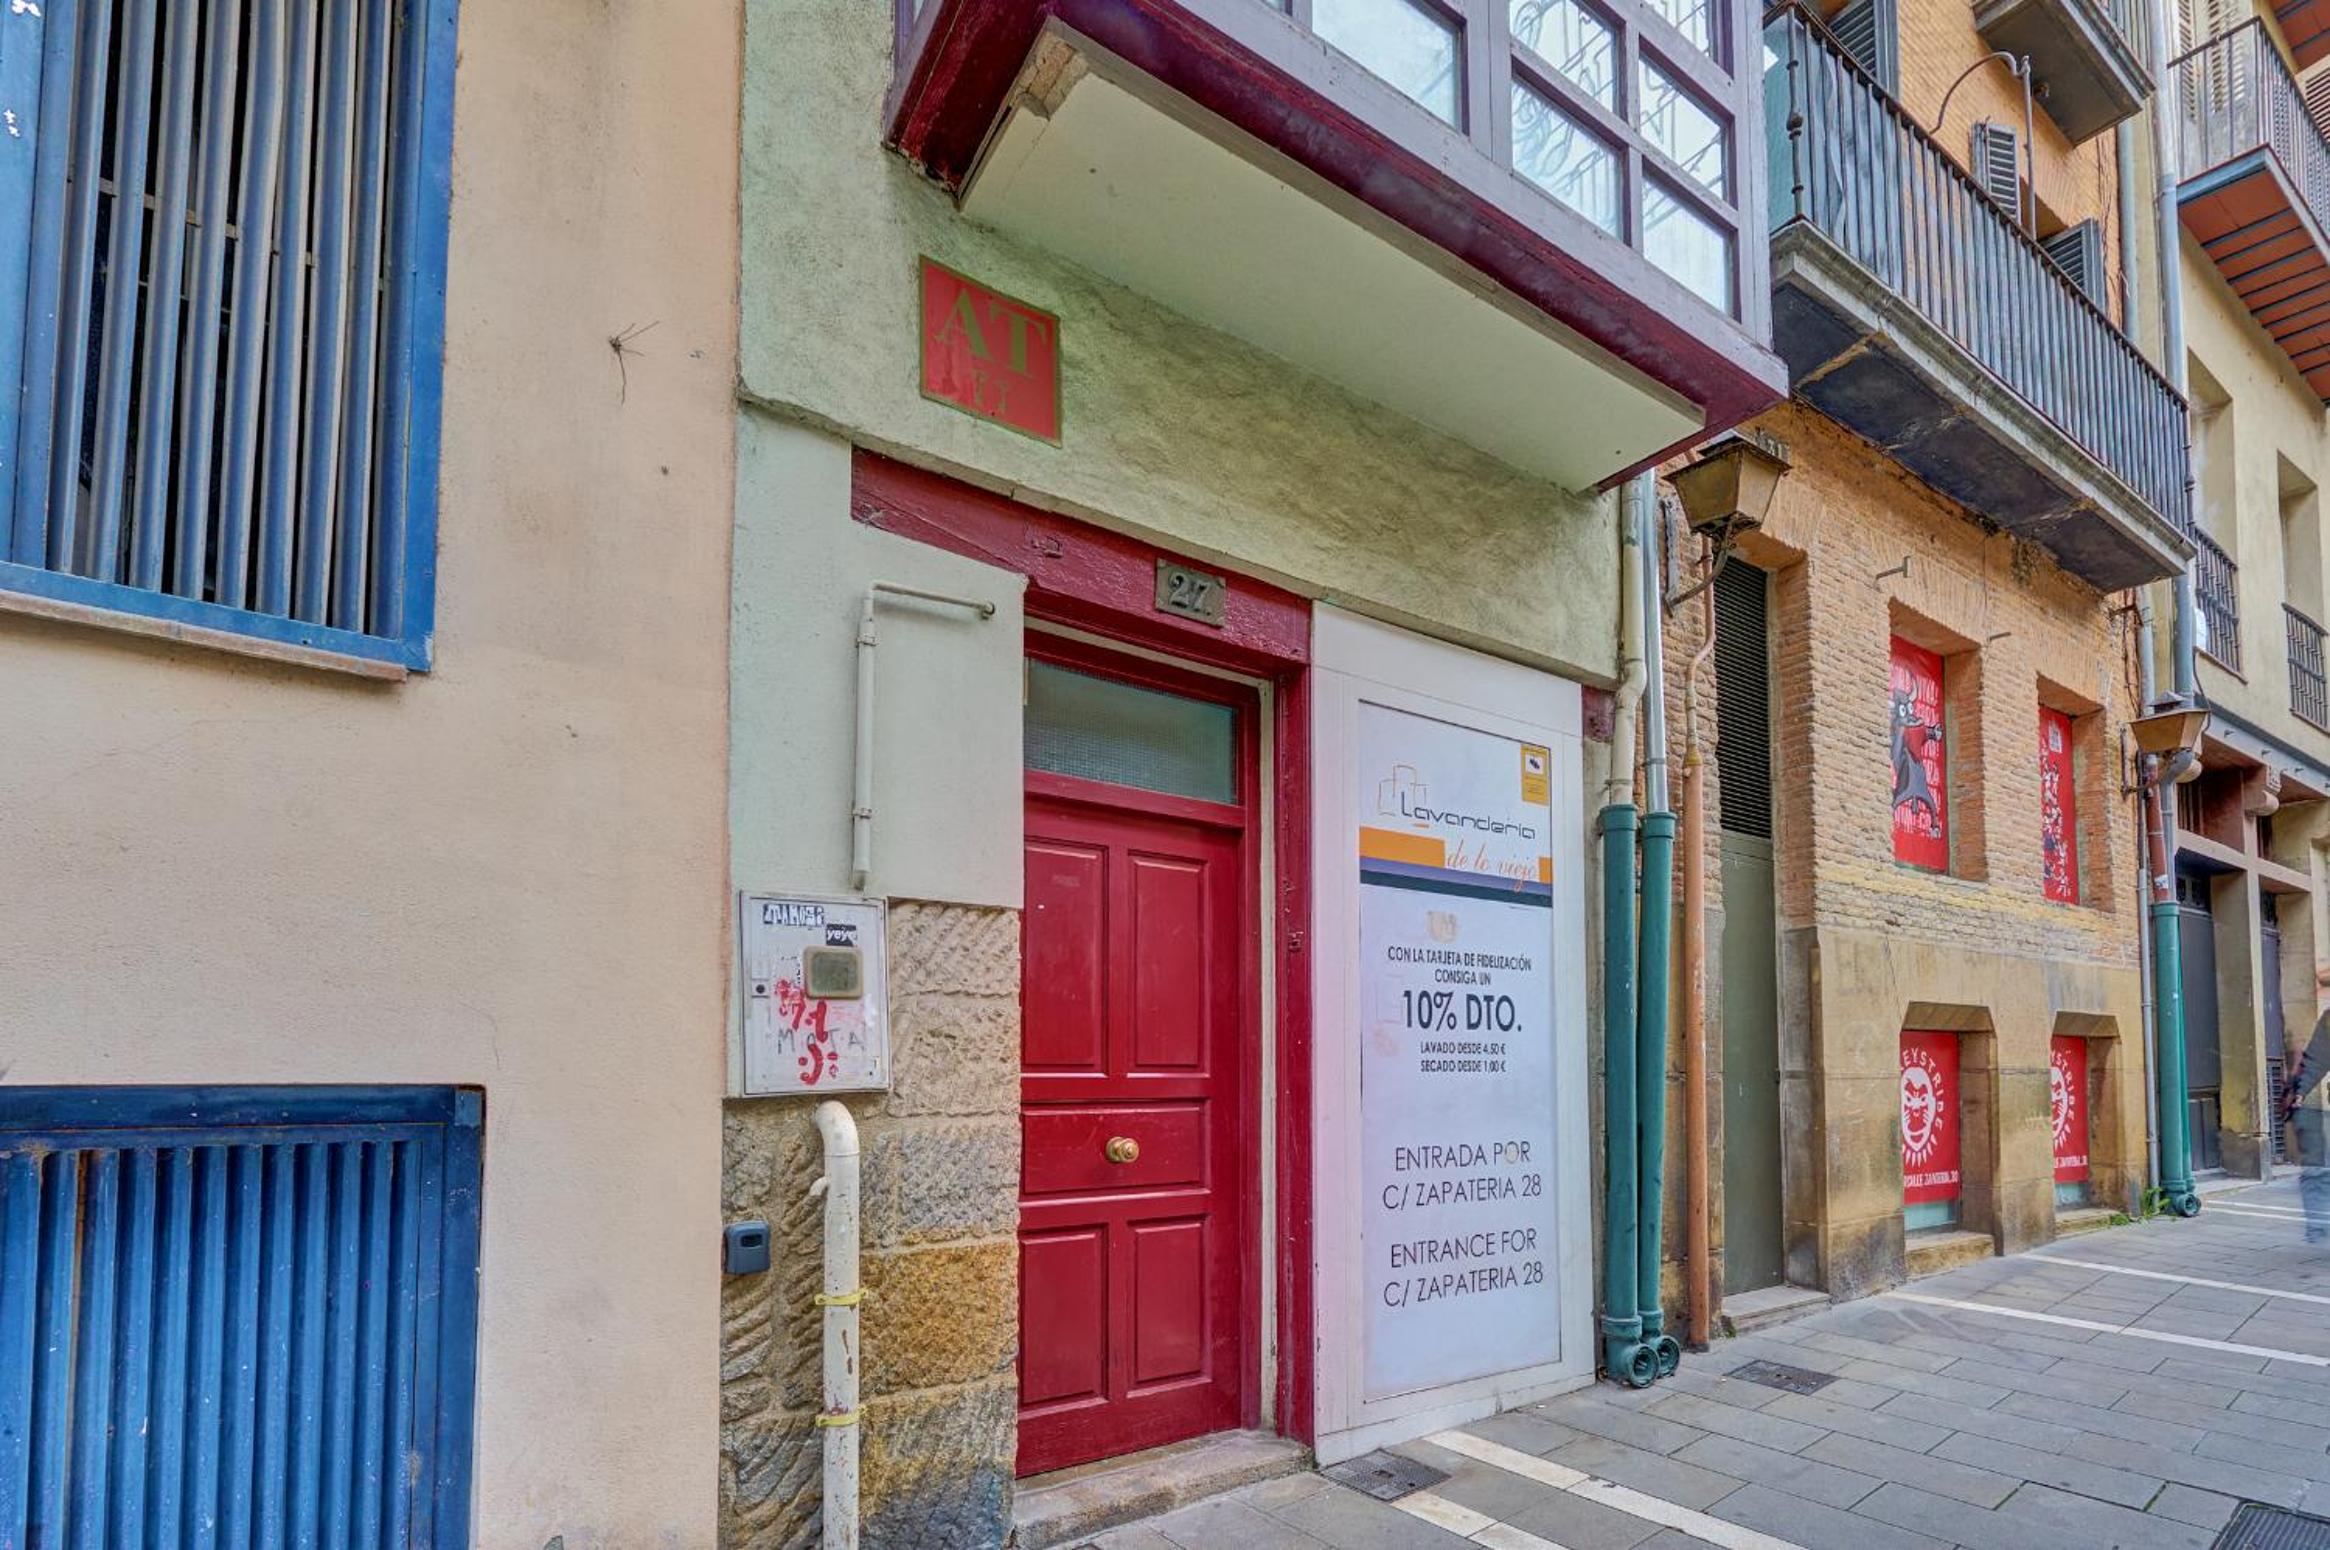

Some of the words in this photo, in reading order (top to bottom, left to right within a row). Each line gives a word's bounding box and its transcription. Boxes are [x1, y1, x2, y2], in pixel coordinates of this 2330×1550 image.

[935, 288, 1048, 378] AT
[1388, 946, 1411, 961] CON
[1413, 948, 1425, 963] LA
[1426, 949, 1462, 966] TARJETA
[1464, 952, 1476, 967] DE
[1435, 968, 1477, 985] CONSIGA
[1403, 989, 1457, 1031] 10%
[1466, 994, 1522, 1032] DTO.
[1420, 1041, 1456, 1054] LAVADO
[1457, 1042, 1481, 1054] DESDE
[1420, 1060, 1456, 1073] SECADO
[1457, 1060, 1481, 1073] DESDE
[1395, 1144, 1487, 1171] ENTRADA
[1493, 1141, 1531, 1165] POR
[1382, 1184, 1409, 1210] C/
[1416, 1177, 1516, 1207] ZAPATERIA
[1522, 1173, 1542, 1197] 28
[1391, 1232, 1495, 1268] ENTRANCE
[1501, 1228, 1536, 1254] FOR
[1383, 1279, 1410, 1307] C/
[1417, 1267, 1518, 1303] ZAPATERIA
[1523, 1261, 1543, 1286] 28
